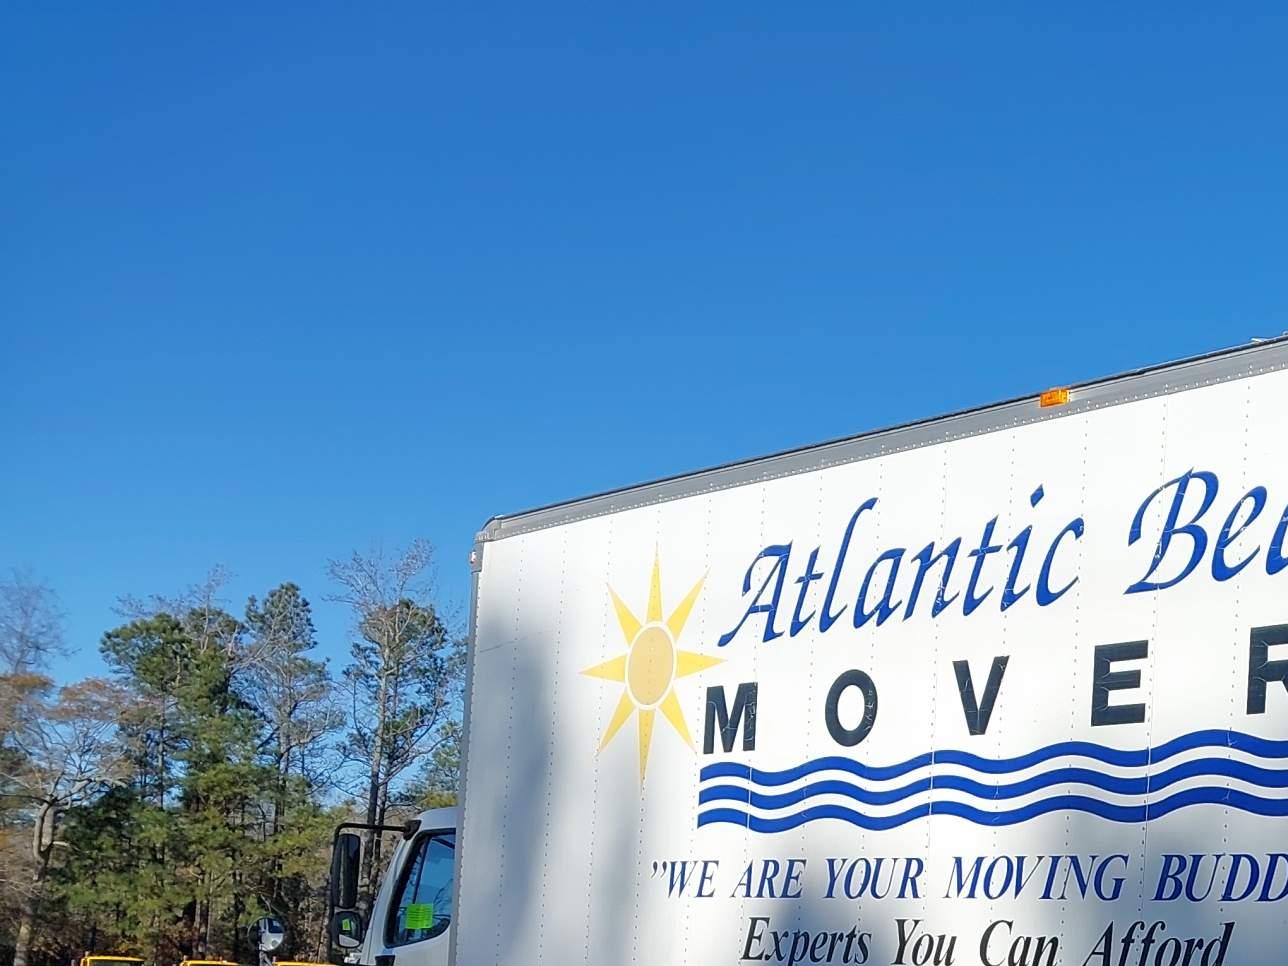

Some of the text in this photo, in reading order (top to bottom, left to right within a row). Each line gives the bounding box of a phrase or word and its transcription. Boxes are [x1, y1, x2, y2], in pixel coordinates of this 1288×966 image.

[717, 484, 1085, 648] Atlantic
[730, 858, 807, 899] ARE
[824, 857, 925, 900] YOUR
[944, 855, 1129, 902] MOVING
